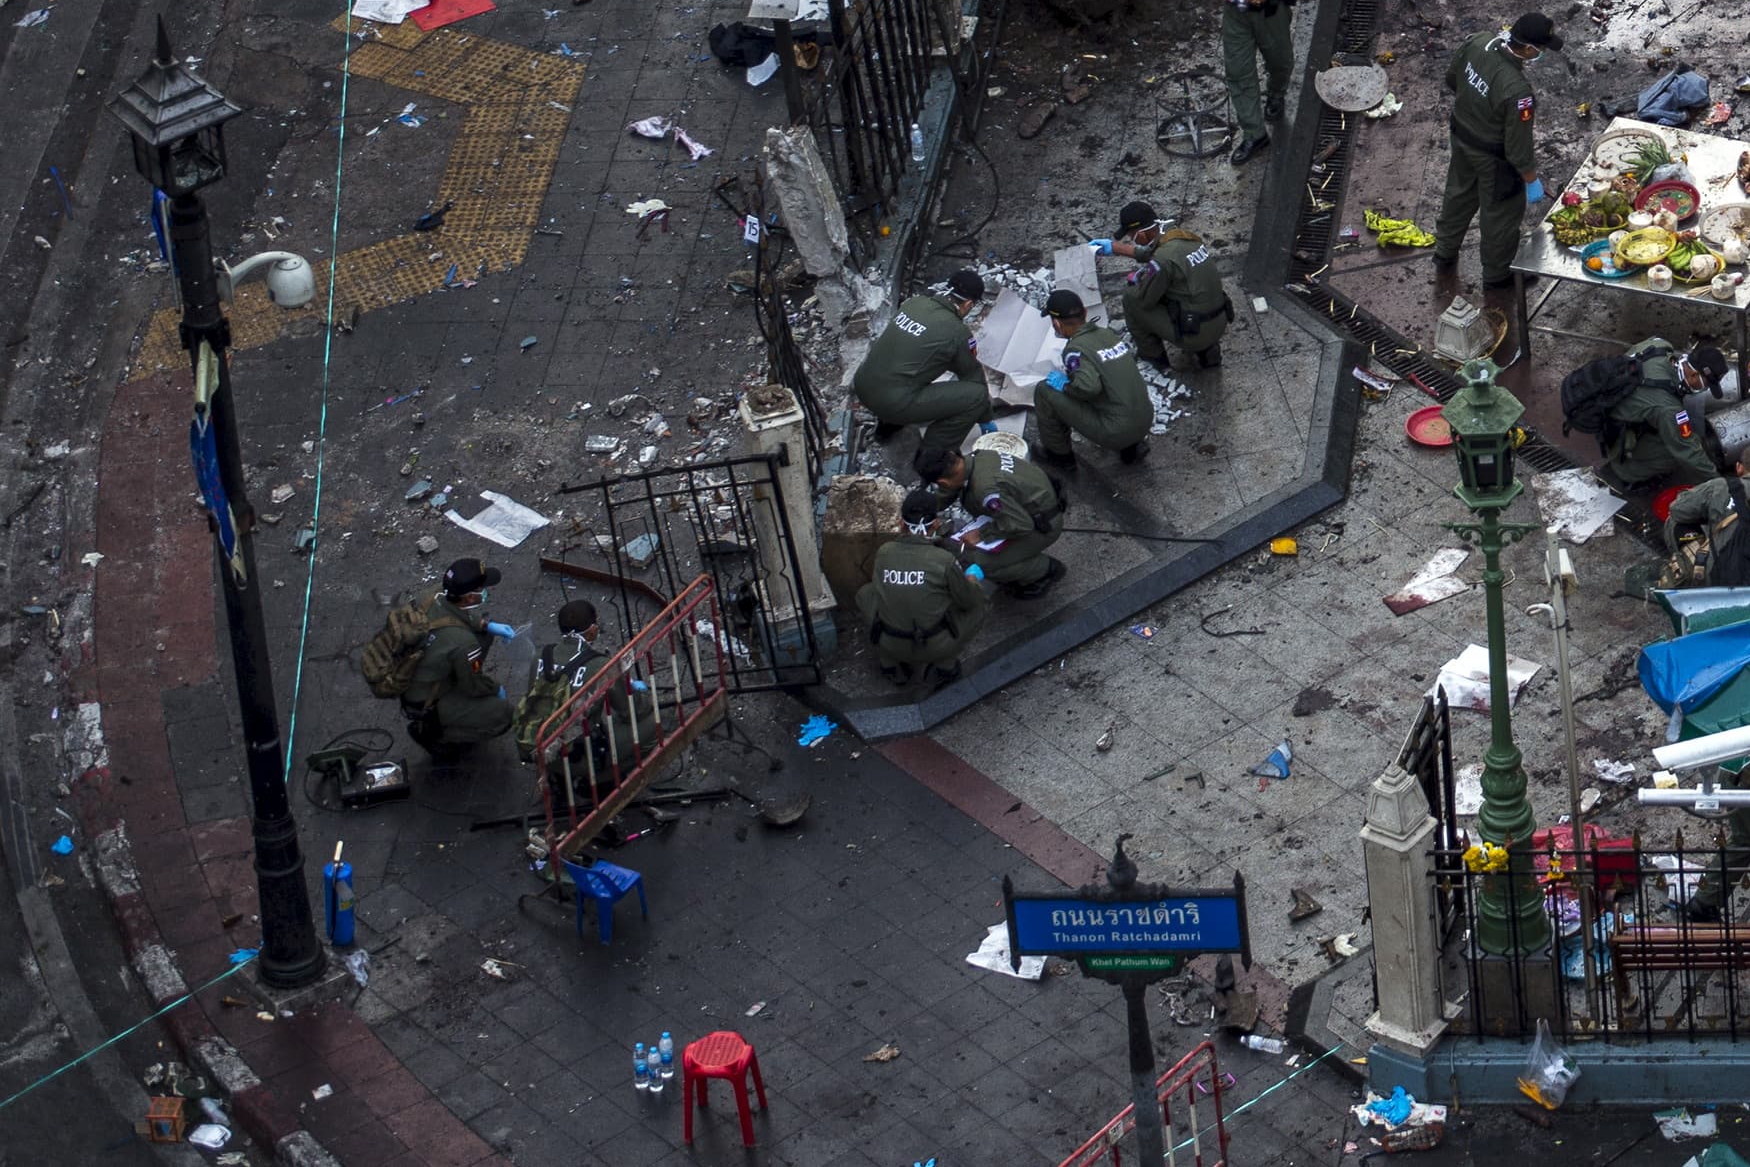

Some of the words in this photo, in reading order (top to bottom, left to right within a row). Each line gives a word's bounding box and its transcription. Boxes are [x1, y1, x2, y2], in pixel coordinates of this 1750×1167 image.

[1464, 61, 1490, 97] POLICE
[748, 221, 758, 236] 15
[883, 569, 925, 586] POLICE
[1051, 901, 1201, 927] ถนนราชดำริ
[1053, 931, 1106, 943] Thanon
[1111, 930, 1201, 943] Ratchadamri
[1091, 957, 1113, 967] Khet
[1114, 957, 1149, 967] Pathum
[1150, 957, 1170, 967] Wan
